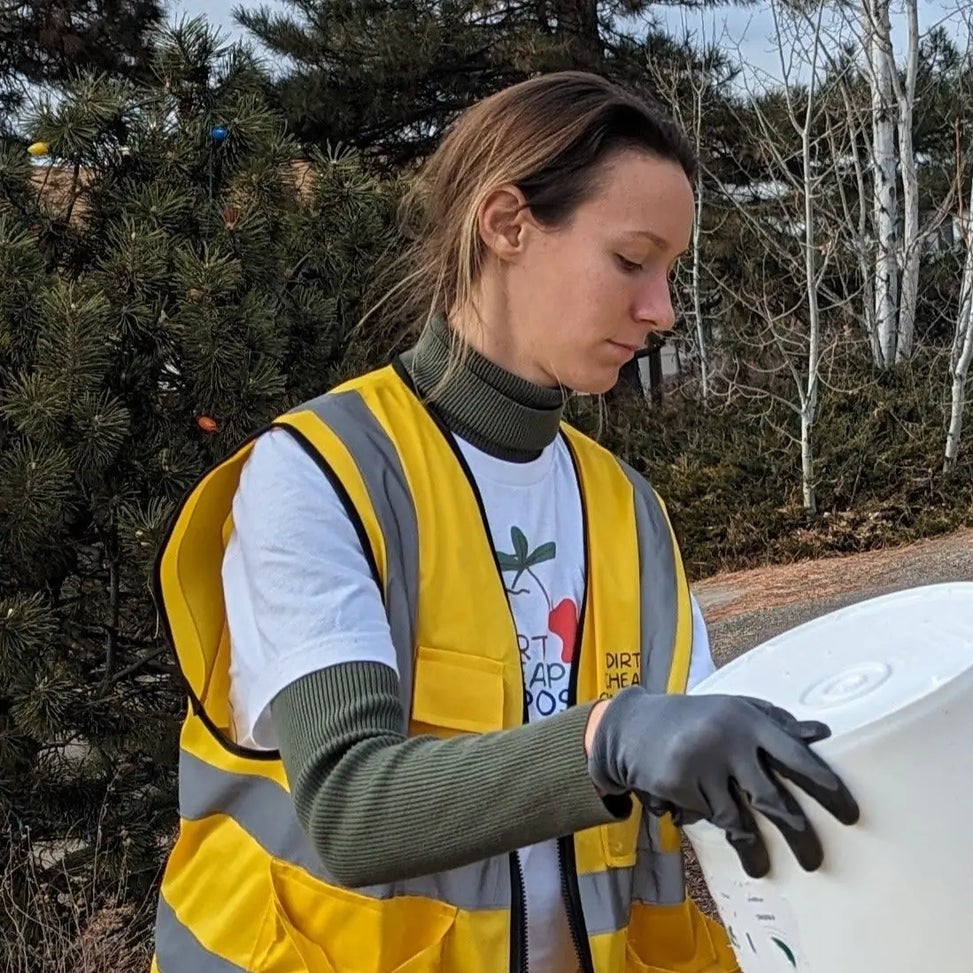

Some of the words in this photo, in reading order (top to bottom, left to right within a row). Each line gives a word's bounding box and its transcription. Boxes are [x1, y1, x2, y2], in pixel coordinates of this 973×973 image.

[517, 634, 548, 661] RT
[606, 652, 640, 669] DIRT
[606, 672, 640, 689] HEA
